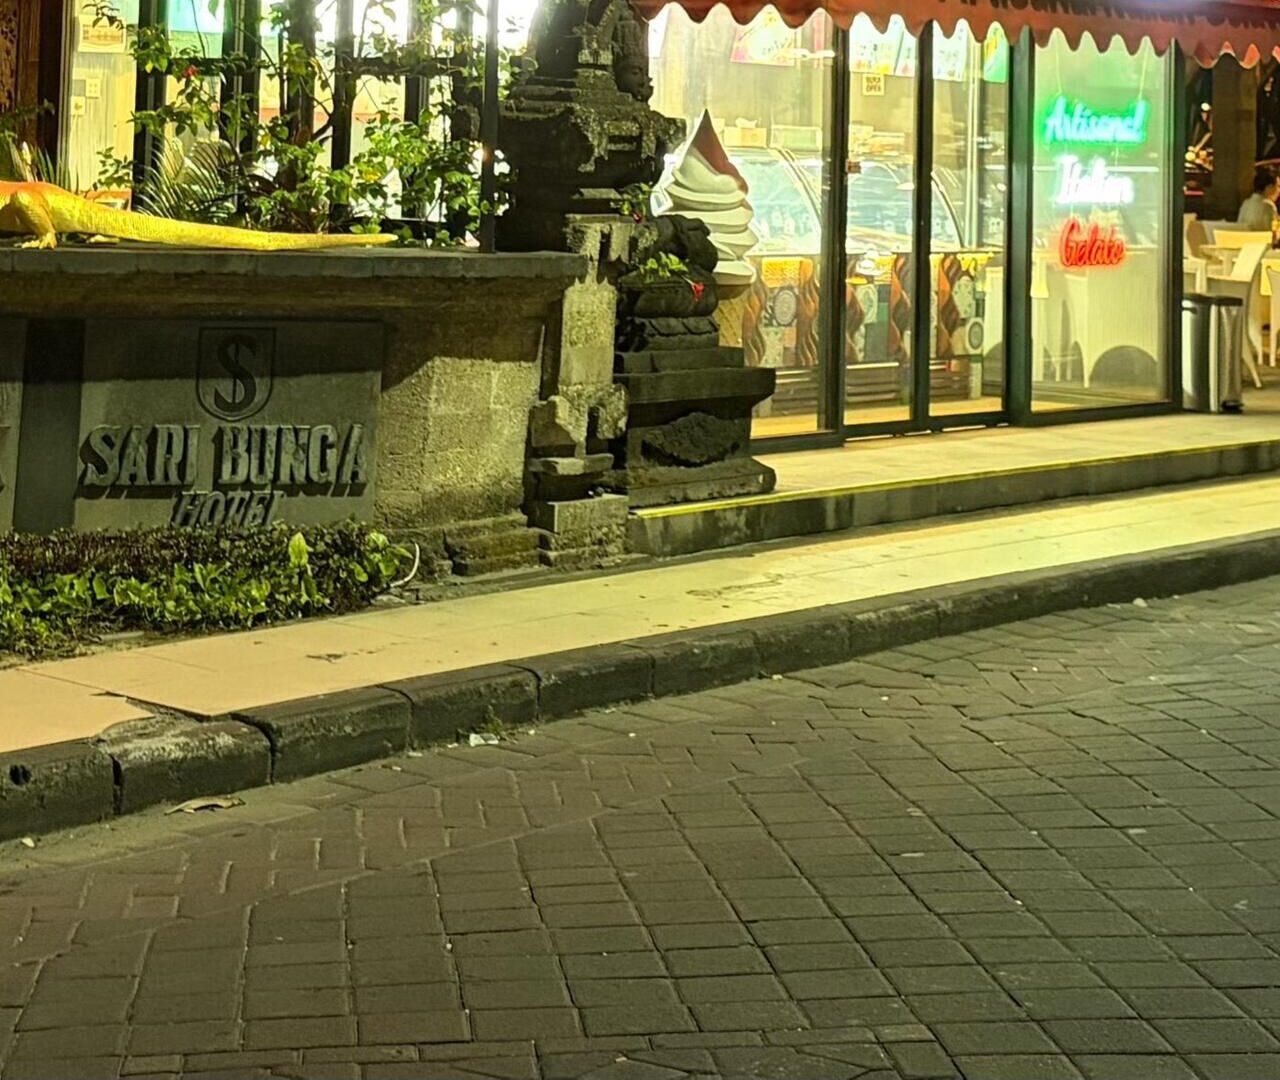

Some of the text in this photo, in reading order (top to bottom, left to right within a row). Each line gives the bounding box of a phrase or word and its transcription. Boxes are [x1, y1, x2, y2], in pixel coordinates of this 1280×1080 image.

[1060, 218, 1126, 267] Gelato
[81, 424, 369, 488] SARI BUNGA
[173, 490, 286, 529] HOTEL
